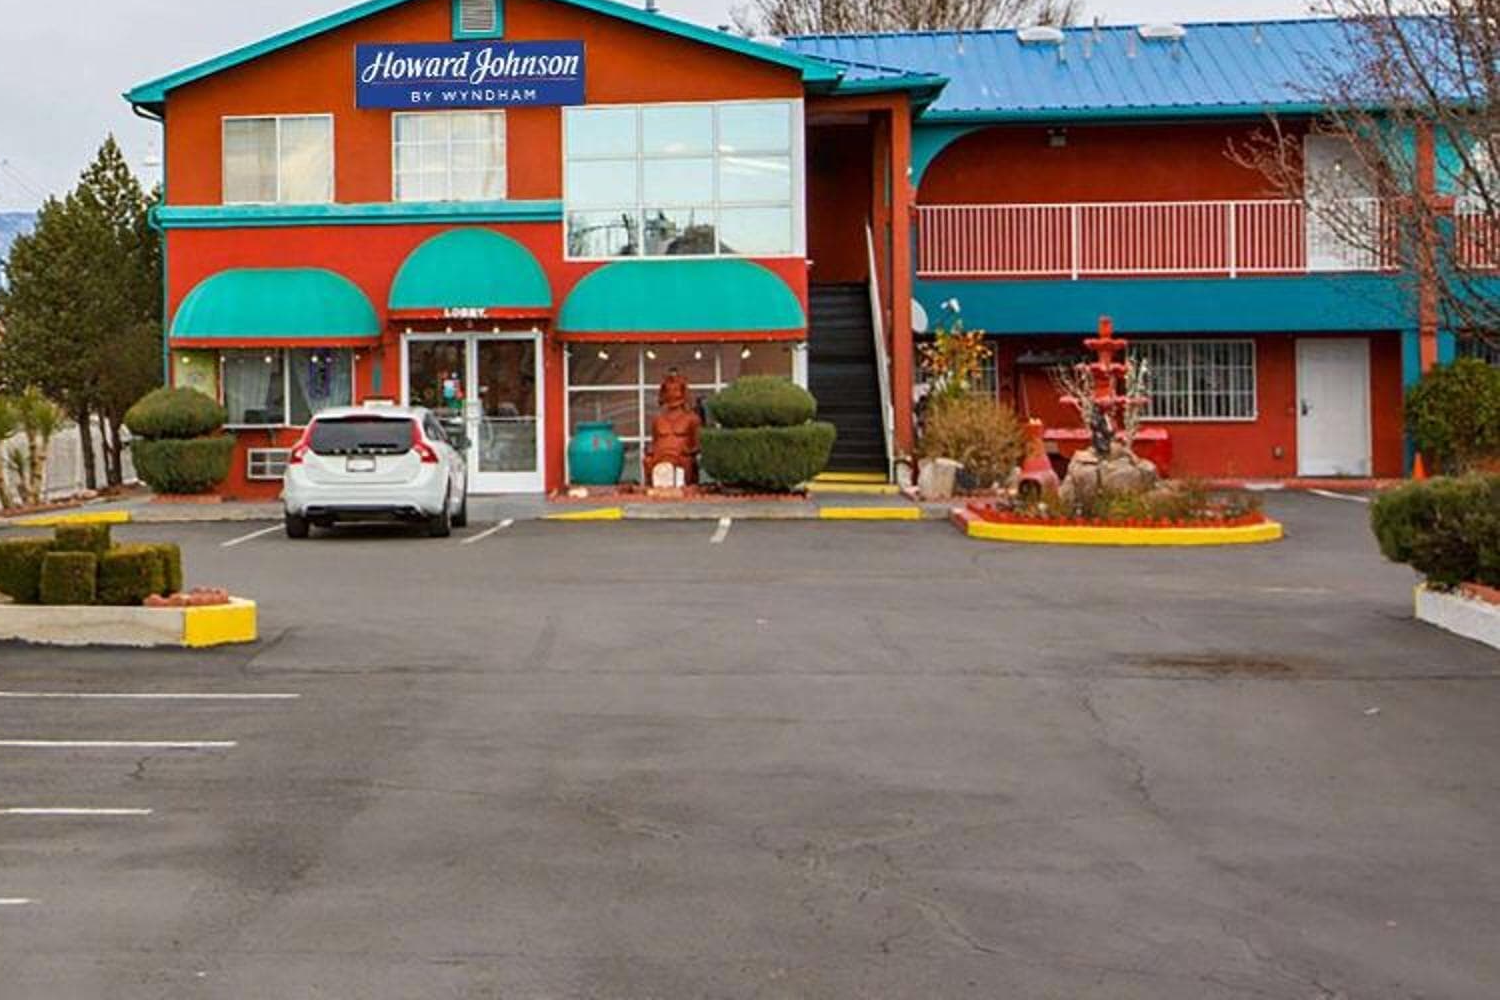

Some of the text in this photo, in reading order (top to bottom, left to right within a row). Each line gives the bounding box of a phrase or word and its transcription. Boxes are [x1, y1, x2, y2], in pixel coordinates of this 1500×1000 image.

[361, 47, 579, 85] Howard Johnson
[411, 89, 537, 103] BY WYNDHAM
